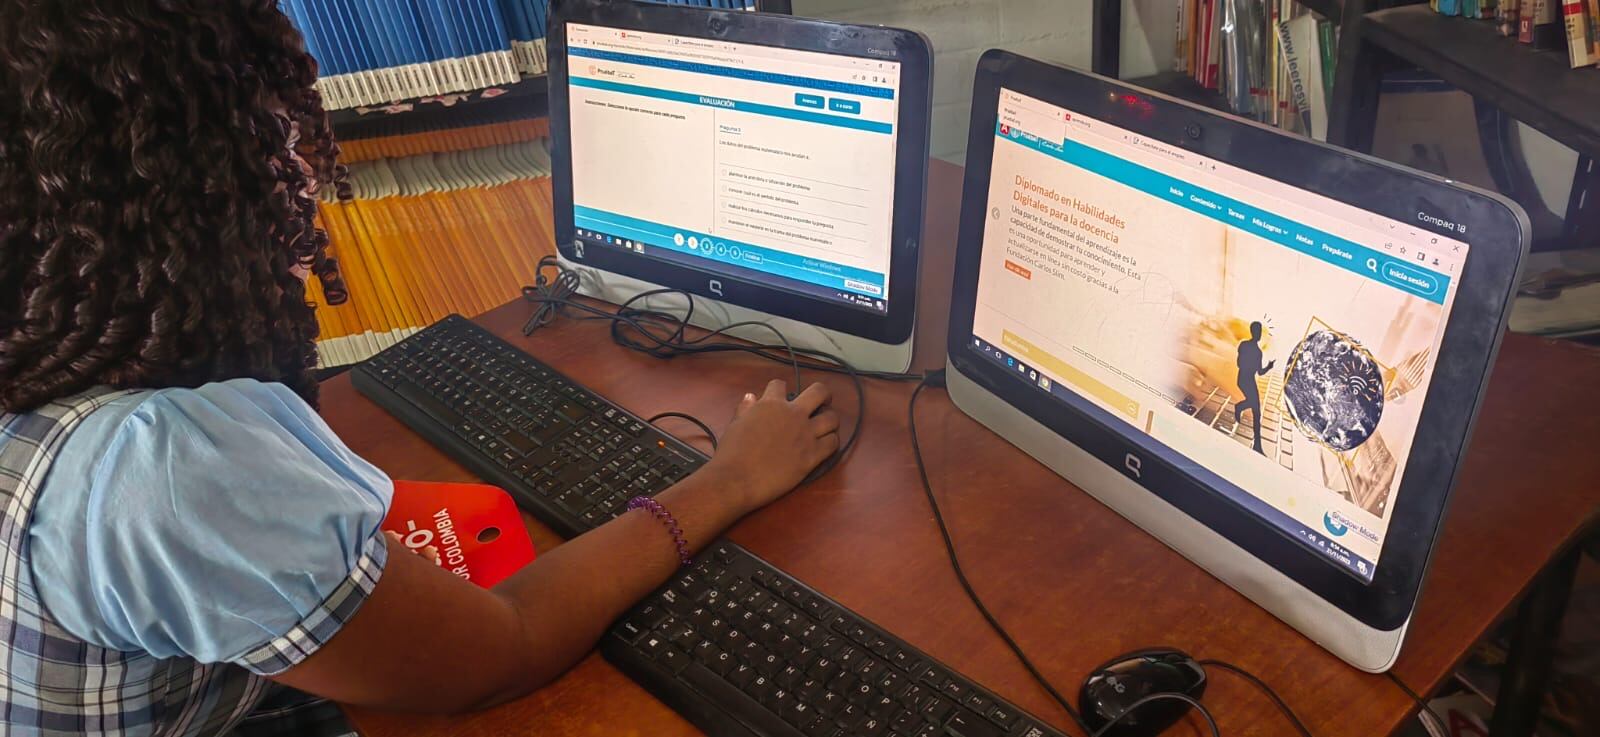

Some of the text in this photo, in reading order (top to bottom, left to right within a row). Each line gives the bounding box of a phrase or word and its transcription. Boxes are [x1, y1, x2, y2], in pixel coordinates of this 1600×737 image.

[699, 95, 734, 108] EVALUACIÓN
[1014, 174, 1125, 229] Diplomado en Habilidades
[1169, 186, 1184, 197] Inicio
[1189, 193, 1216, 209] Contenido
[1012, 190, 1119, 244] Digitales para la docencia
[1227, 208, 1245, 220] Tareas
[1418, 211, 1467, 234] Compaq 18
[1011, 204, 1136, 266] Una parte fundamental del aprendizaje es la
[1252, 217, 1282, 234] Mis Logros
[1010, 214, 1037, 234] capacidad
[1037, 227, 1045, 236] de
[1045, 230, 1075, 250] demostrar
[1082, 247, 1126, 274] conocimiento.
[1127, 268, 1141, 280] Esta
[1295, 233, 1314, 245] Notas
[1006, 246, 1033, 265] Fundación
[1034, 260, 1051, 274] Carlos
[1008, 226, 1105, 277] es una oportunidad para aprender y
[1321, 242, 1353, 260] Prepárate
[1007, 236, 1038, 257] actualizarse
[1039, 252, 1046, 260] en
[1047, 255, 1060, 267] línea
[1061, 262, 1069, 271] sin
[1070, 266, 1086, 279] costo
[1086, 274, 1107, 290] gracias
[1112, 285, 1118, 294] la
[1388, 268, 1430, 288] Inicia sesión
[433, 507, 465, 565] COLOMBIA
[1360, 525, 1378, 542] Mode
